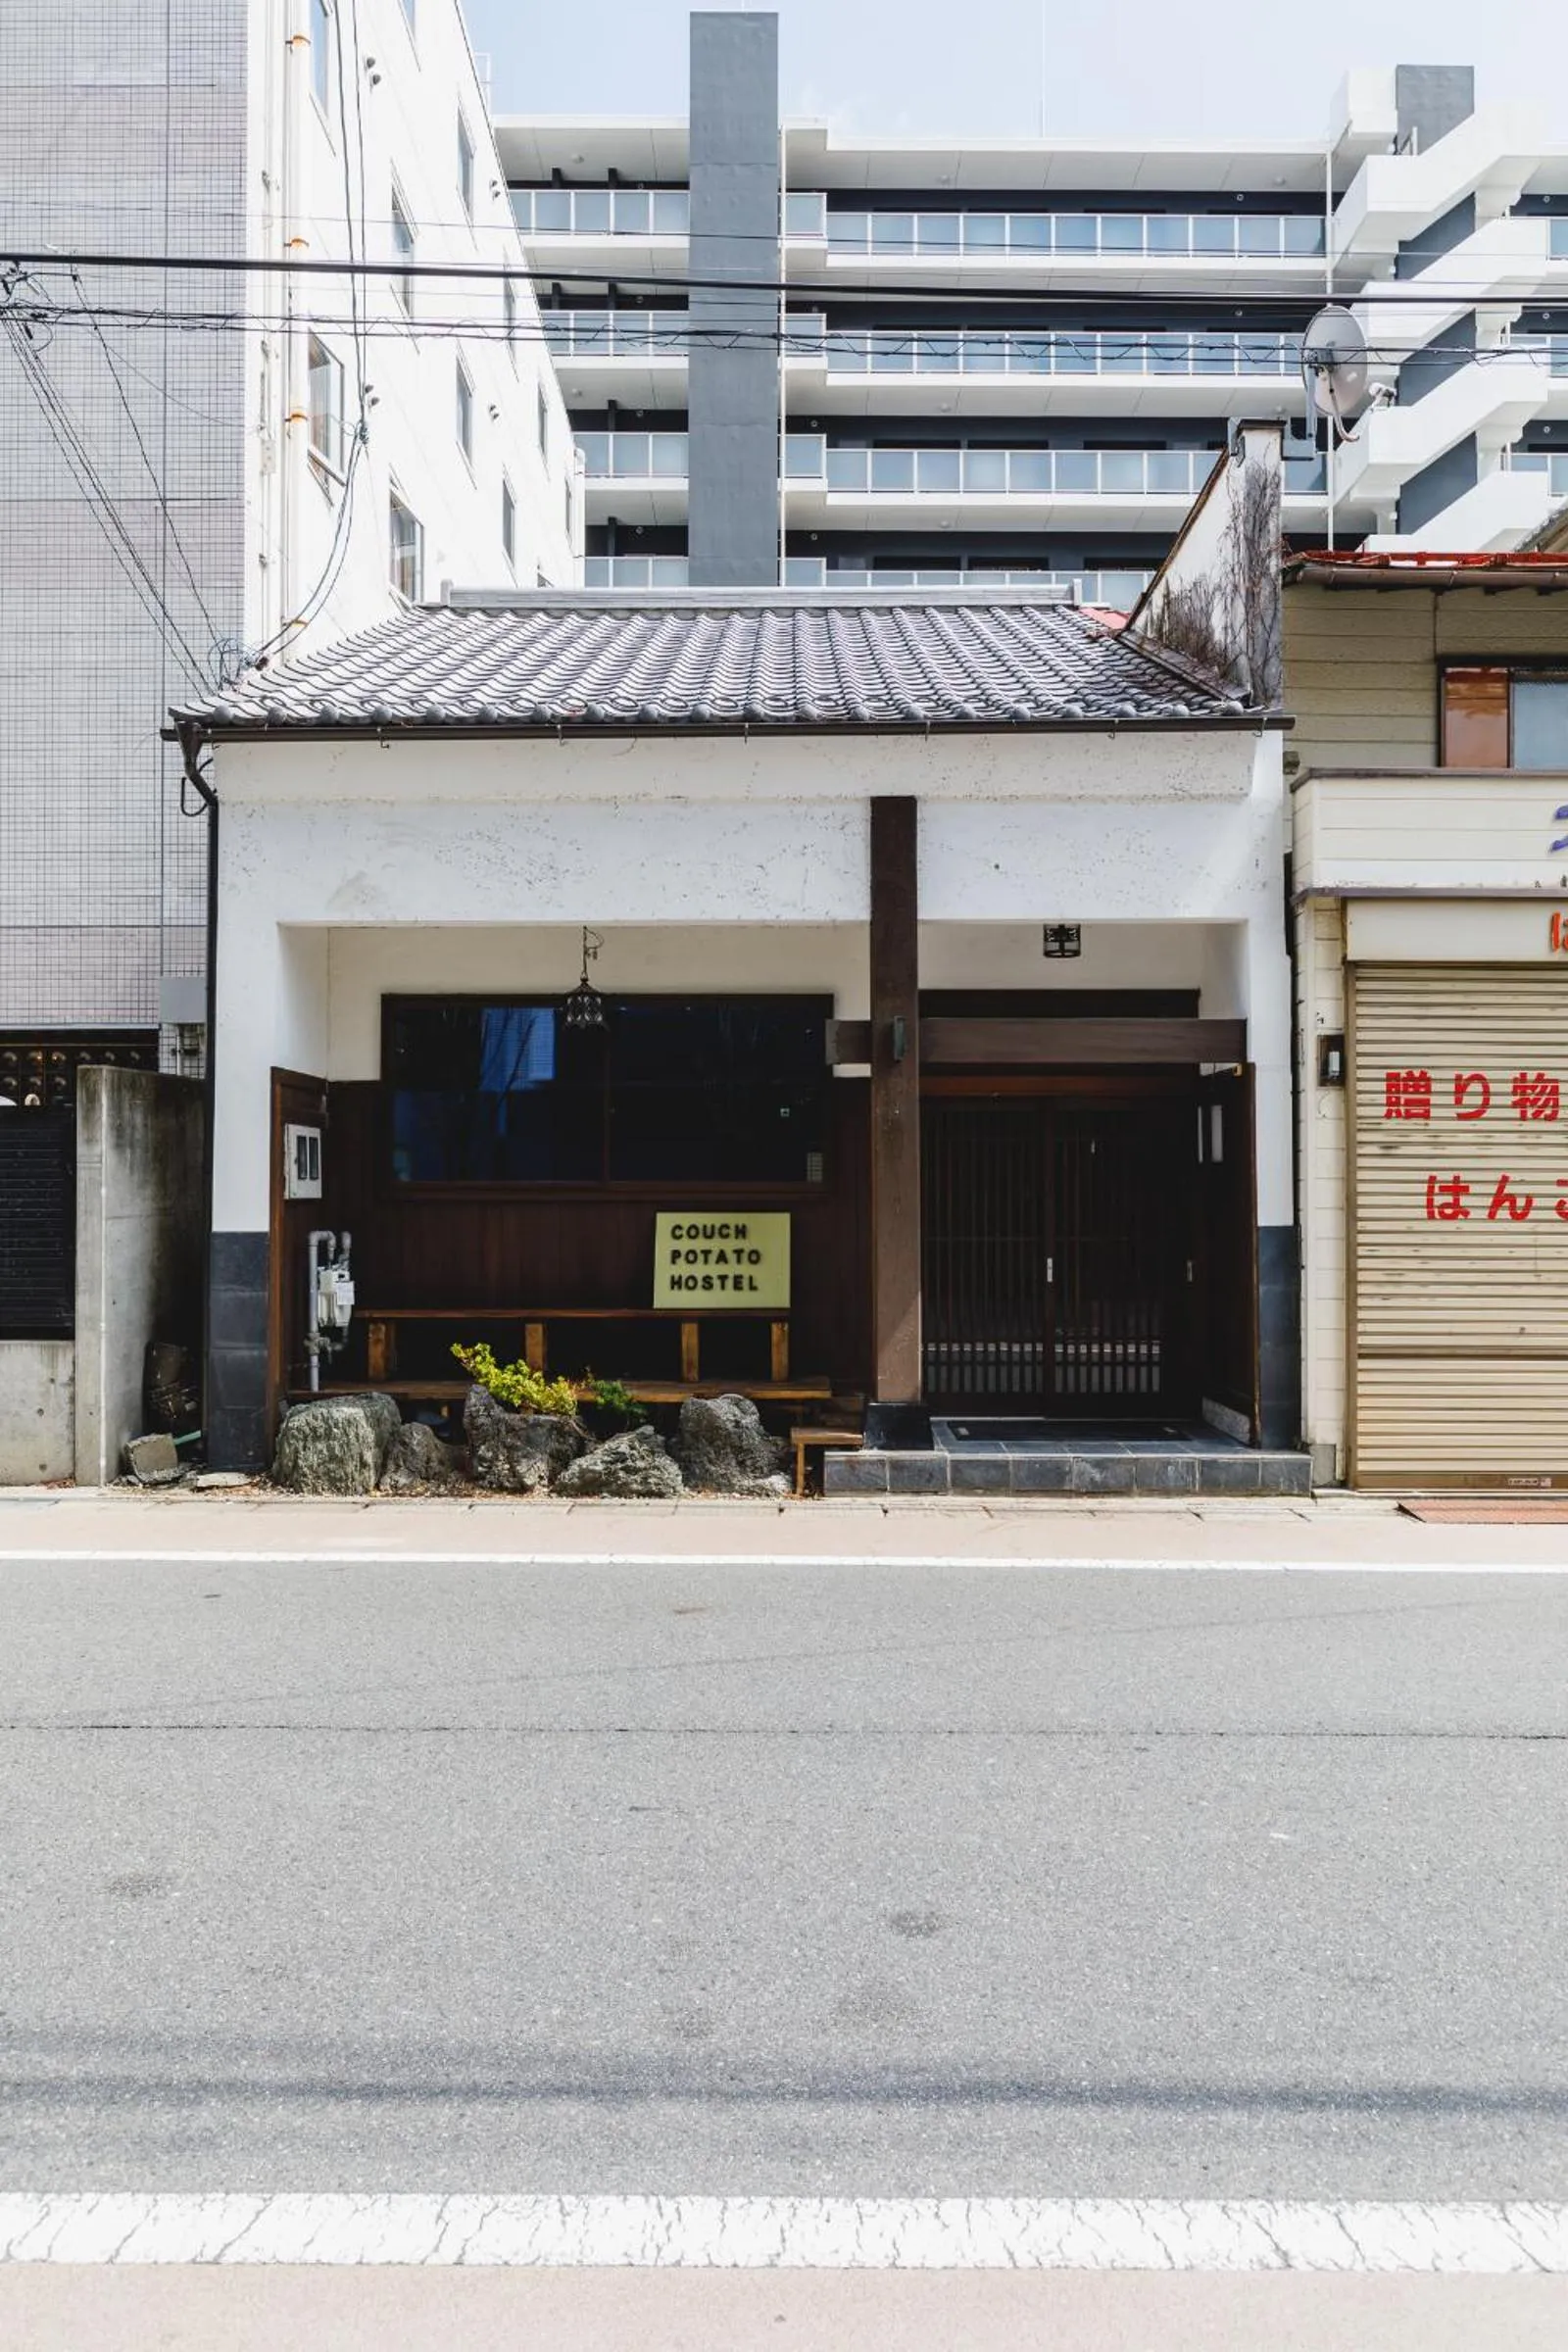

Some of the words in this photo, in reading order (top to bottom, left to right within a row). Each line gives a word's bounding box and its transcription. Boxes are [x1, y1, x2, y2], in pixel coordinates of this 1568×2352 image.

[1384, 1070, 1560, 1121] 贈り物
[1426, 1174, 1568, 1220] はん
[670, 1224, 748, 1240] COUCH
[670, 1249, 761, 1265] POTATO
[669, 1275, 759, 1291] HOSTEL
